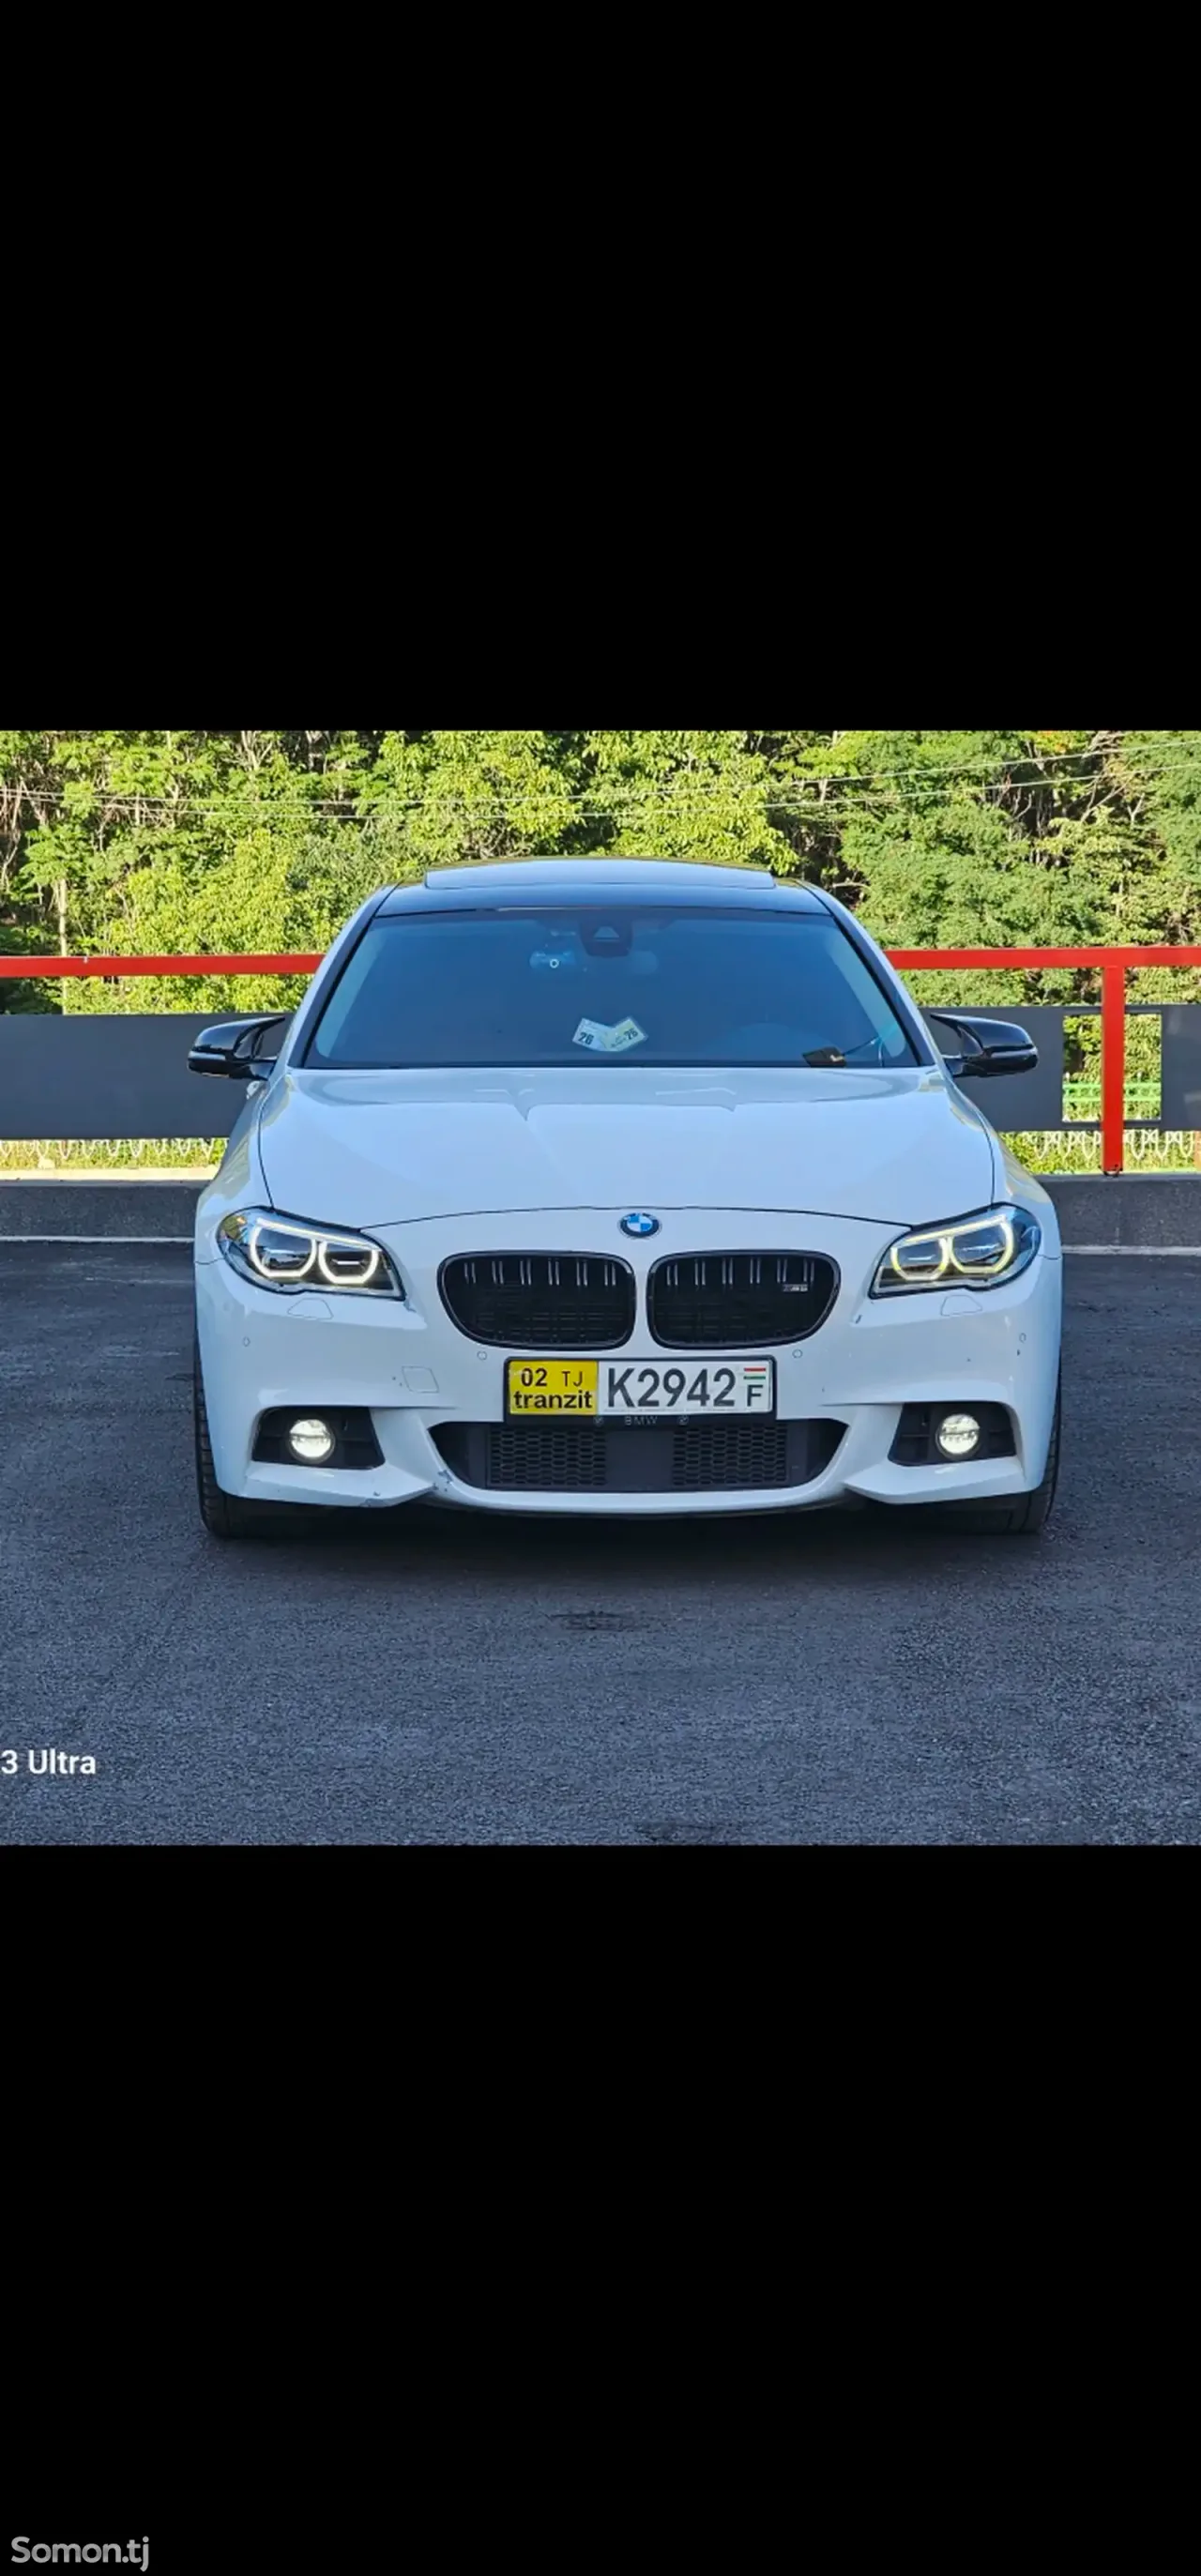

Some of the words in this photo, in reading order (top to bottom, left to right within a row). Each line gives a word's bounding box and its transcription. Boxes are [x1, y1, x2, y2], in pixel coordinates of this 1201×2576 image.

[521, 1367, 548, 1387] 02
[561, 1370, 584, 1387] TJ
[607, 1367, 737, 1408] K2942
[746, 1384, 764, 1408] F
[513, 1389, 593, 1409] tranzit
[624, 1415, 658, 1425] BMW
